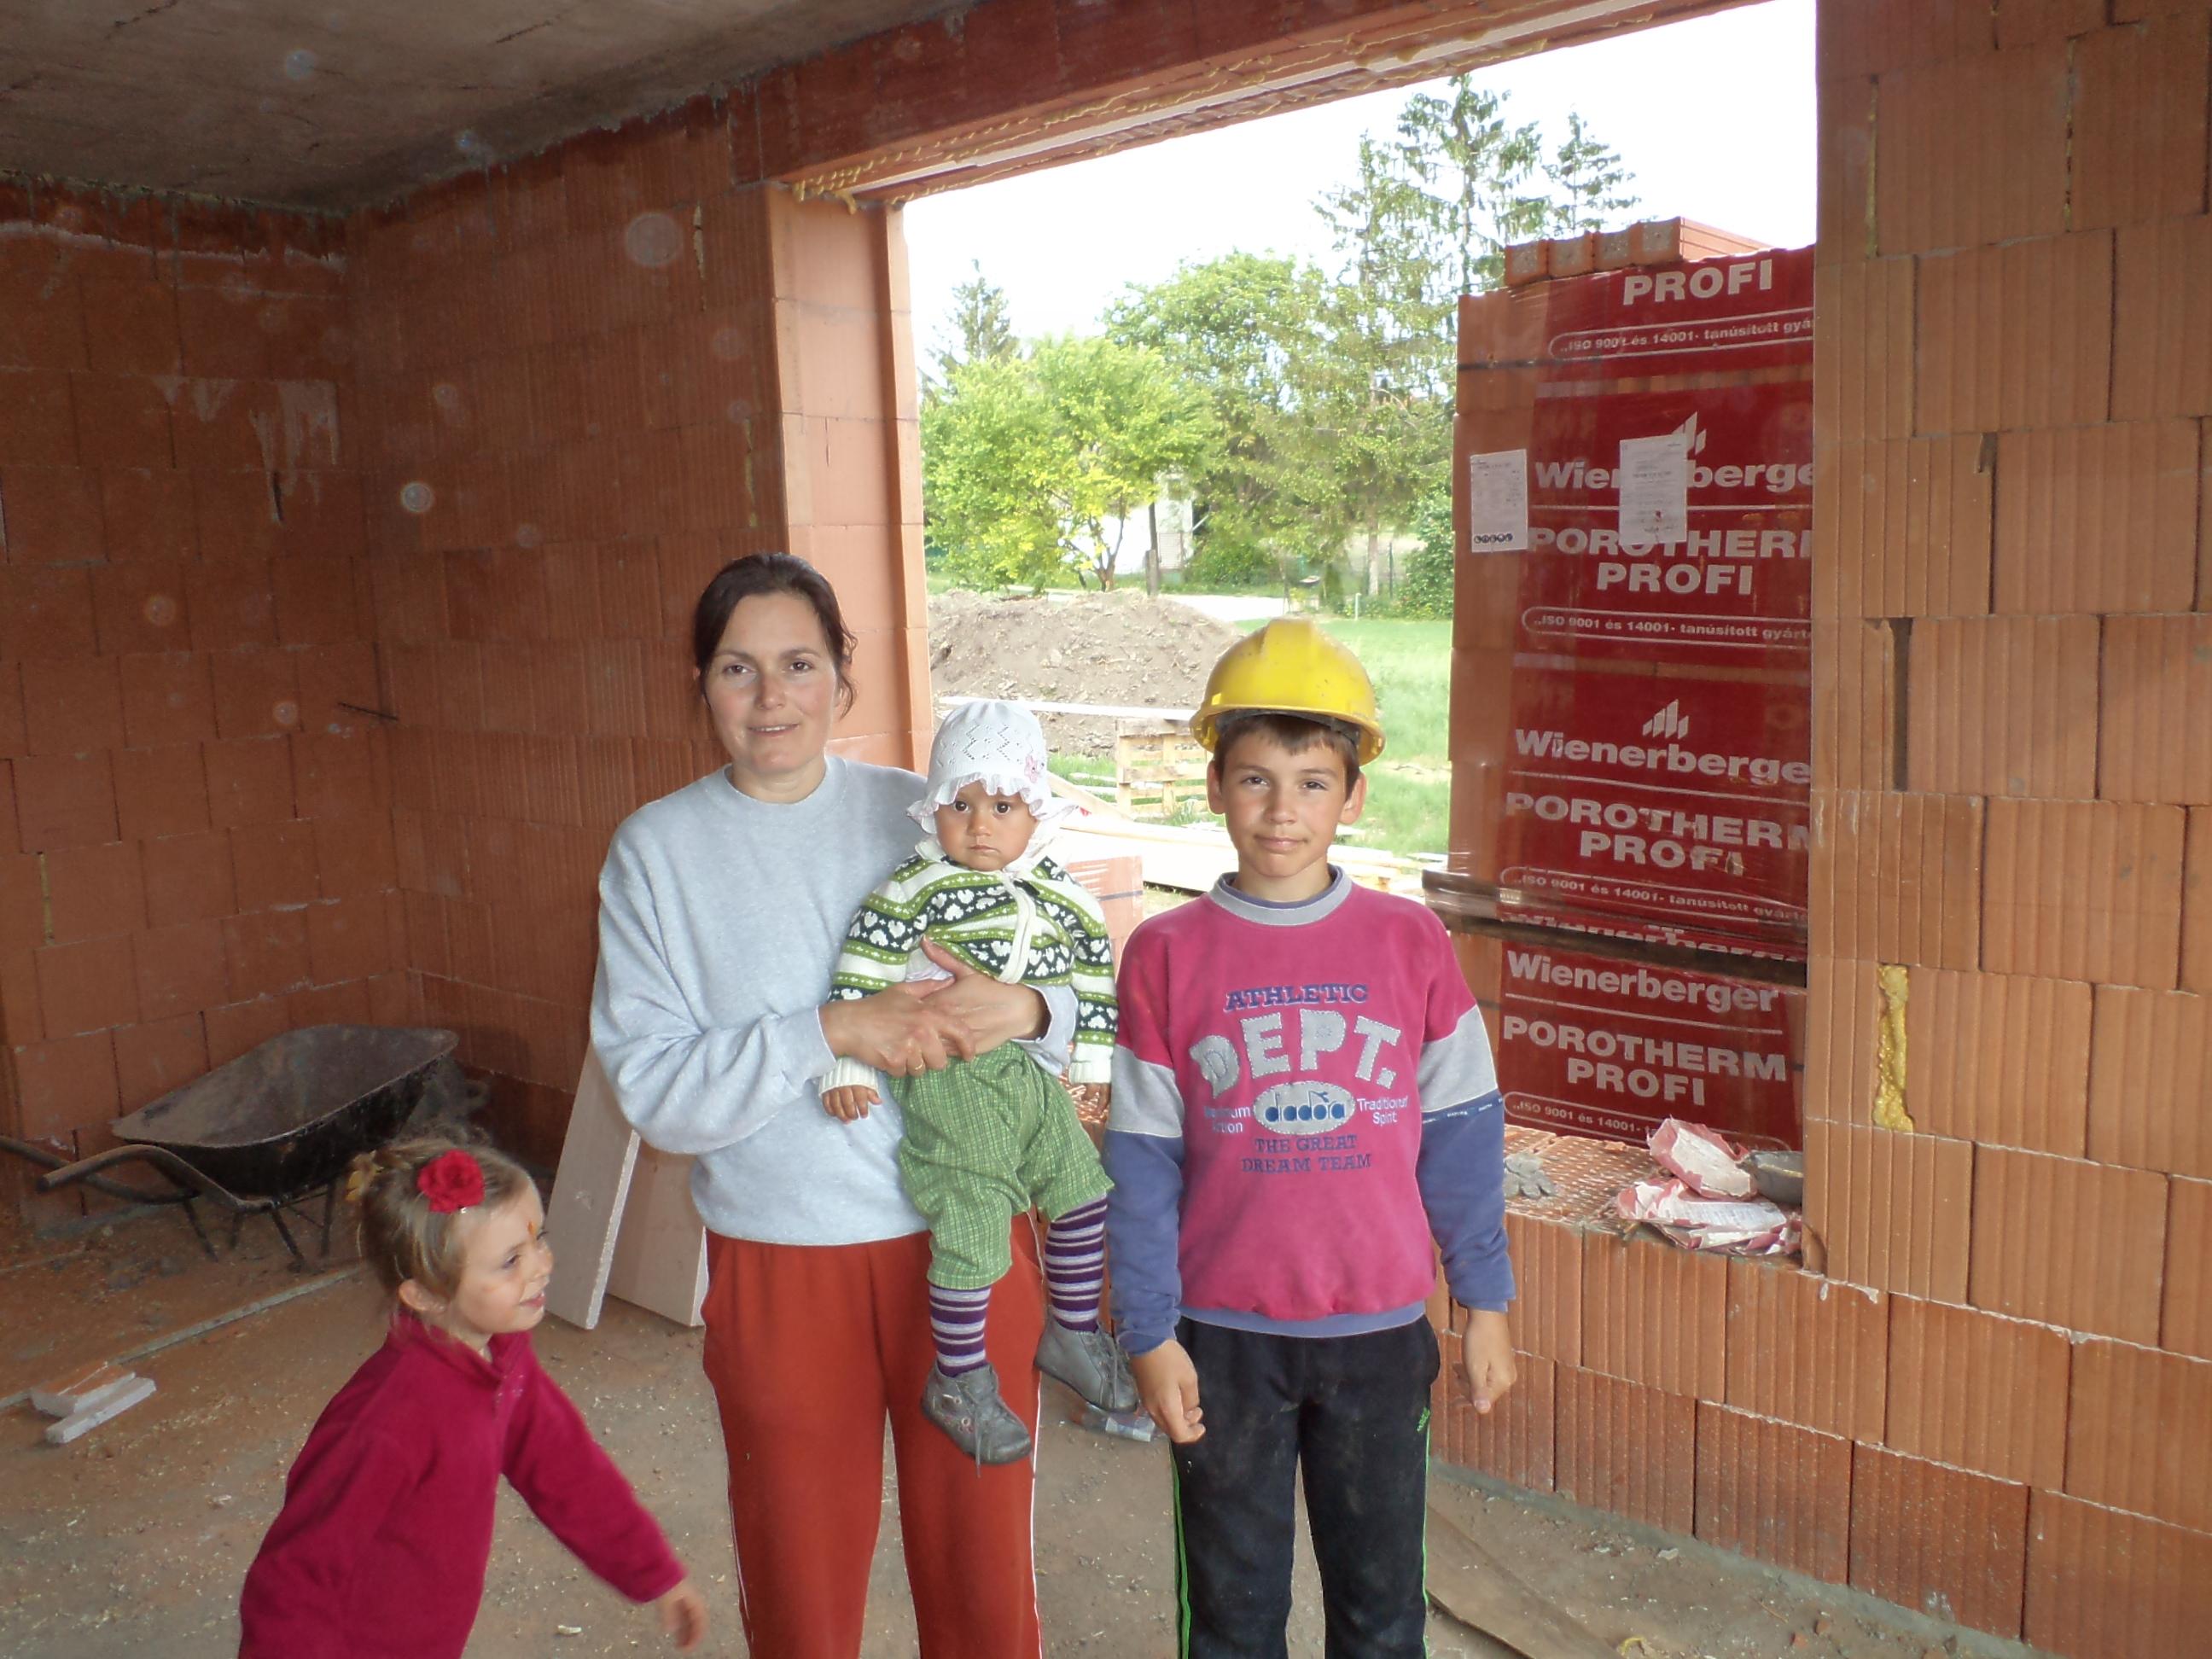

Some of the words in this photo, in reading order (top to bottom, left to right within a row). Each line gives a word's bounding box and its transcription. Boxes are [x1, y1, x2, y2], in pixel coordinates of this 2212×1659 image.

[1623, 259, 1773, 306] PROFI
[1596, 337, 1627, 348] 9001
[1535, 459, 1813, 493] Wieberge
[1527, 527, 1812, 558] PORHER
[1597, 562, 1753, 595] PROFI
[1569, 617, 1600, 628] 9001
[1605, 619, 1621, 630] és
[1680, 624, 1758, 637] tanúsított
[1580, 830, 1743, 876] PROFI
[1551, 878, 1585, 891] 9001
[1223, 983, 1370, 1012] ATHLETIC
[1507, 950, 1779, 1014] Wienerberger
[1503, 1016, 1787, 1081] POROTHERM
[1568, 1058, 1705, 1106] PROFI
[1545, 1106, 1574, 1120] 9001
[1578, 1113, 1593, 1124] és
[1254, 1138, 1290, 1153] THE
[1296, 1134, 1358, 1151] GREAT
[1242, 1157, 1311, 1174] DREAM
[1318, 1154, 1371, 1171] TEAM
